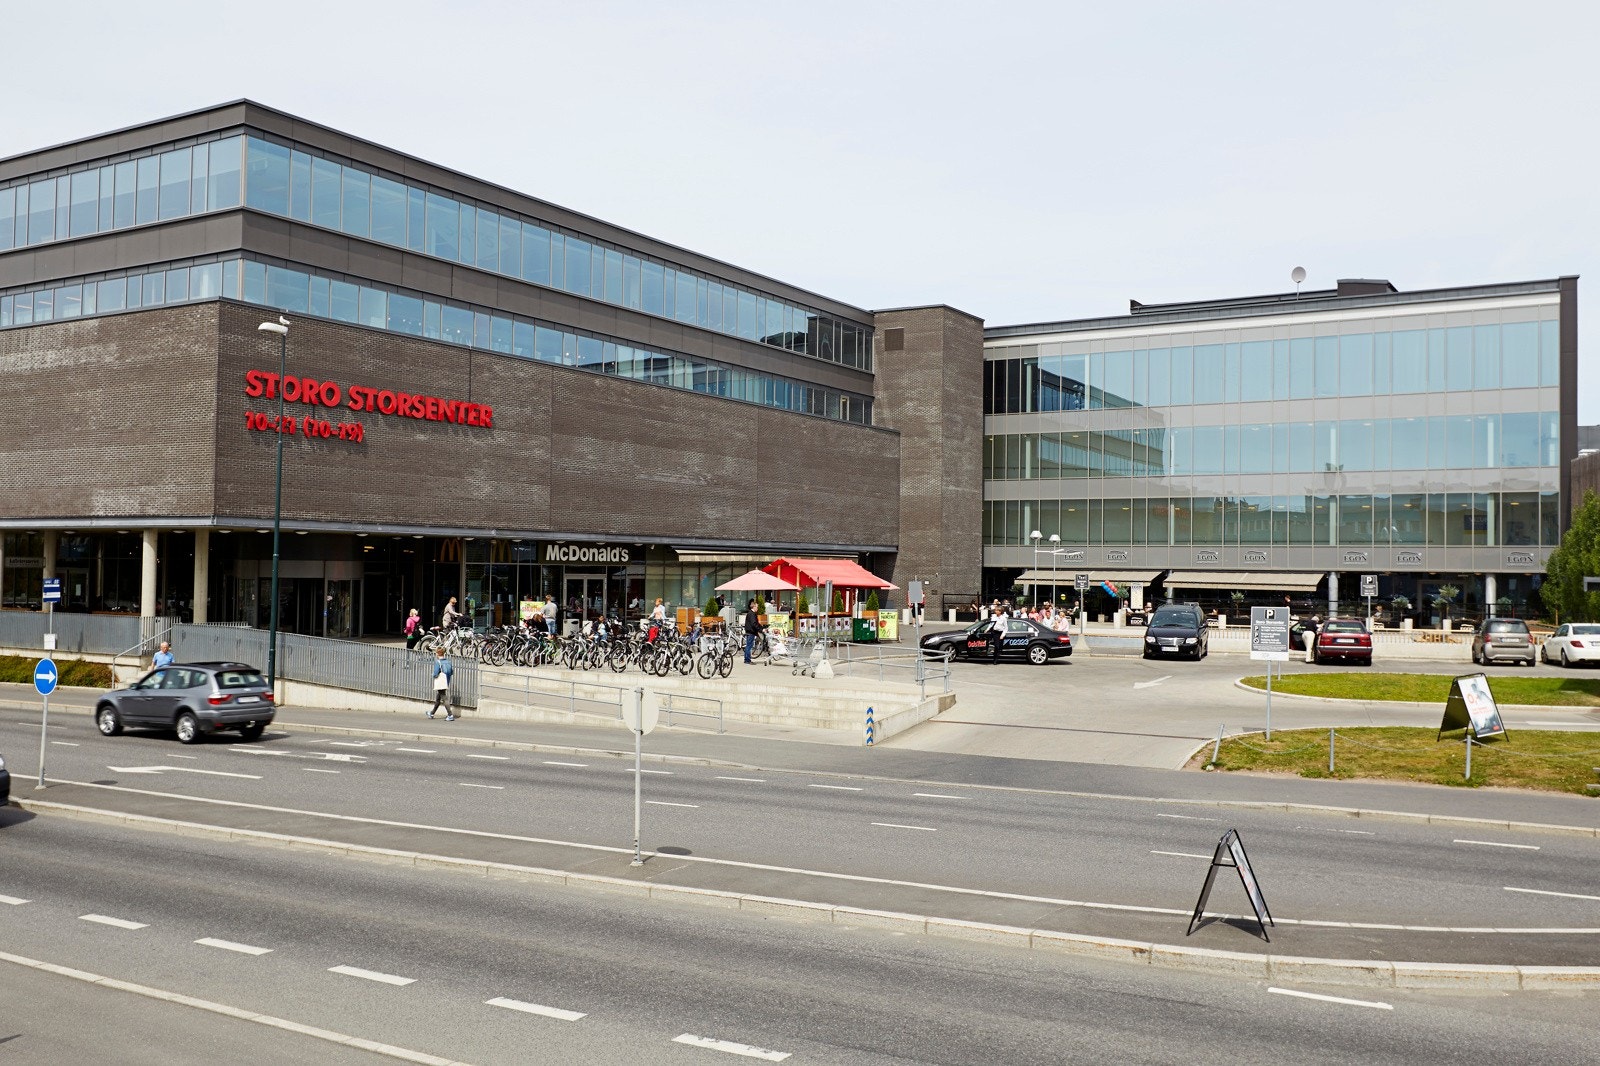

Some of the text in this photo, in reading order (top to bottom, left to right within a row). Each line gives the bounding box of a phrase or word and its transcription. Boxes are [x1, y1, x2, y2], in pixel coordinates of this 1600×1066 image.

[245, 369, 493, 428] STORO STORSENTER
[245, 411, 364, 443] 10-21 (10-19)
[545, 544, 629, 562] McDonald's
[1366, 576, 1373, 584] P
[1266, 609, 1274, 619] P
